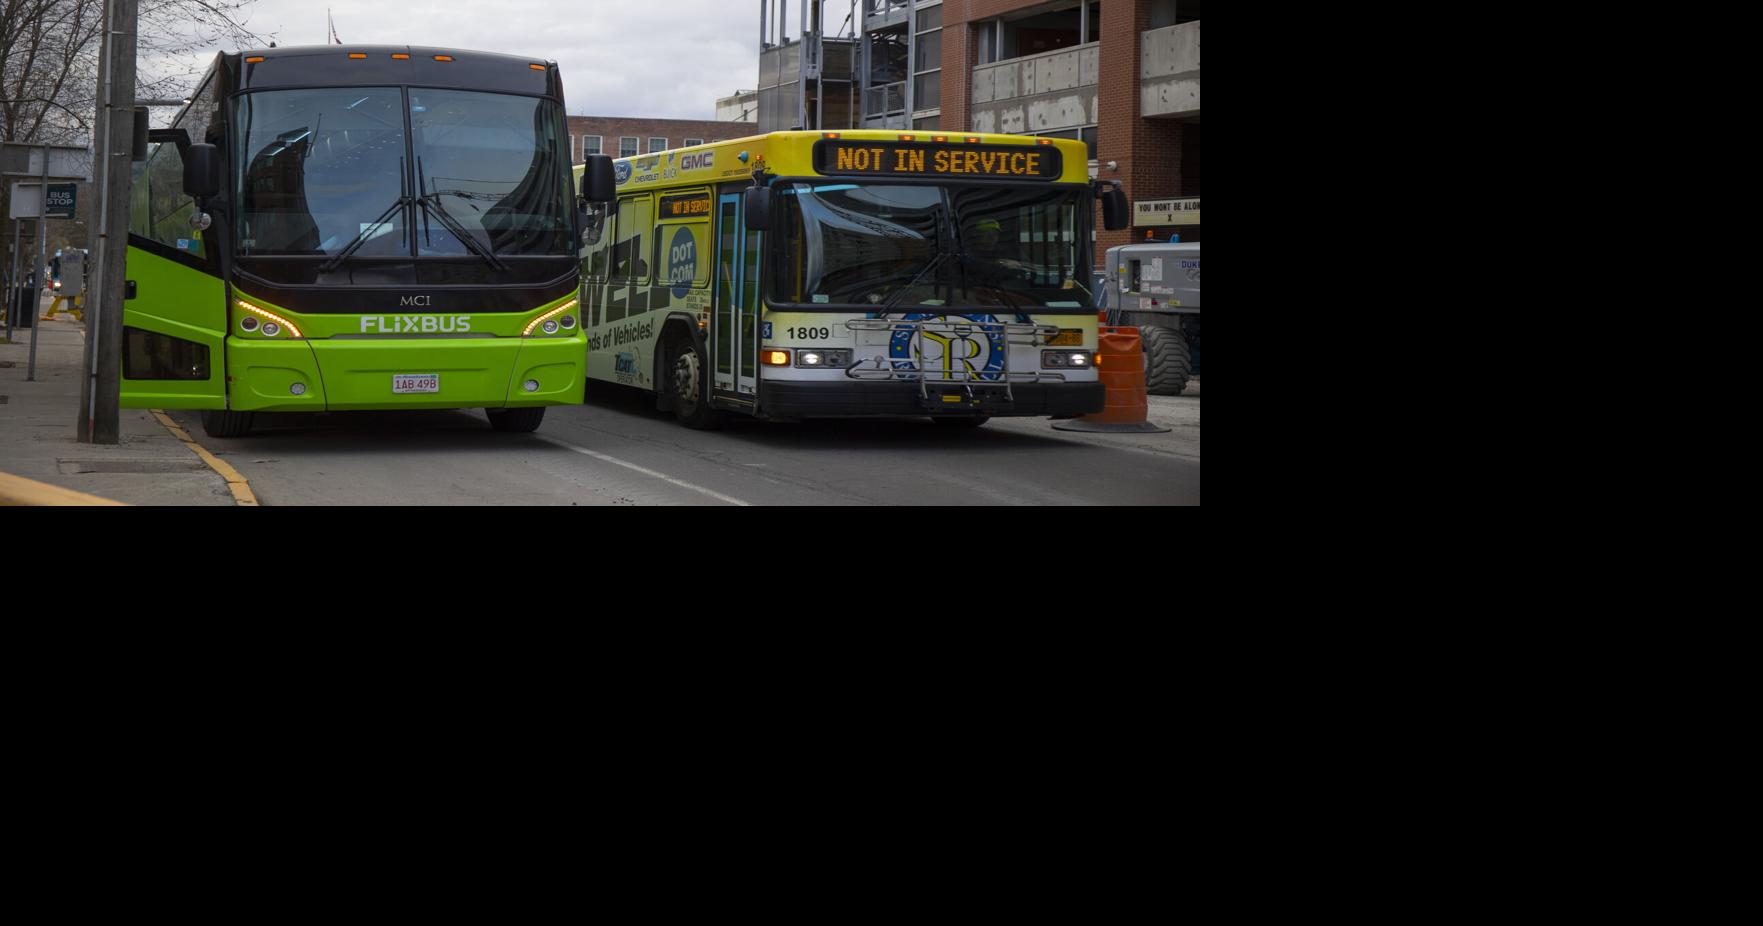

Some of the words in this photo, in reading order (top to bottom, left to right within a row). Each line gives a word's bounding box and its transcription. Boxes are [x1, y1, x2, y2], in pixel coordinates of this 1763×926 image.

[681, 152, 713, 170] GMC
[837, 148, 884, 171] NOT
[894, 149, 924, 172] IN
[934, 150, 1041, 174] SERVICE
[635, 173, 659, 183] CHEVROLET
[672, 201, 681, 214] NOT
[683, 200, 689, 214] IN
[1139, 203, 1151, 212] YOU
[1154, 203, 1170, 211] WONT
[1174, 202, 1181, 210] BE
[672, 241, 693, 263] DOT
[671, 262, 694, 285] COM
[400, 295, 431, 306] MCI
[603, 328, 612, 349] of
[614, 317, 654, 345] Vehicles!
[787, 327, 829, 339] 1809
